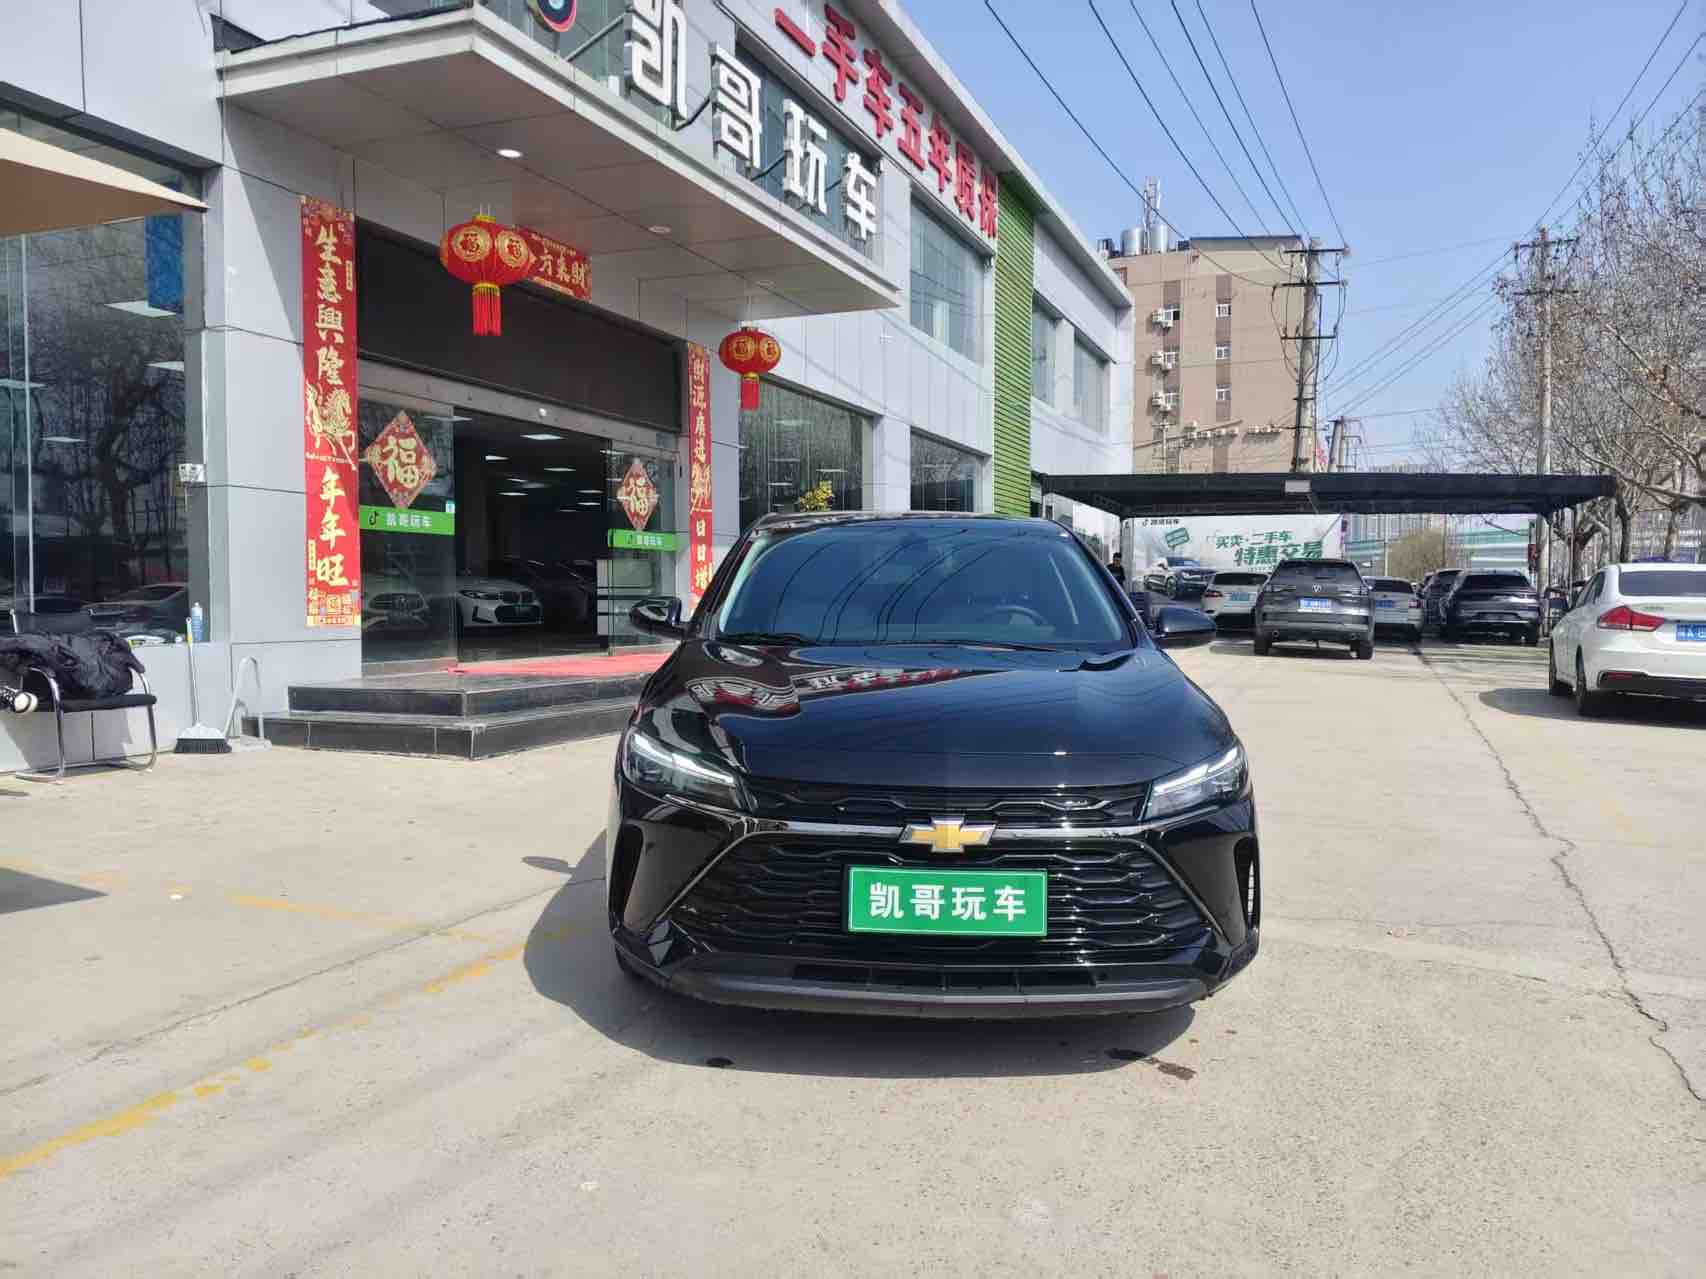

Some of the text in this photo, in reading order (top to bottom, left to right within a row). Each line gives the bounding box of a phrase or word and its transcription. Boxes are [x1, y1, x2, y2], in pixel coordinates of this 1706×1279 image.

[624, 0, 878, 240] 凯哥玩车
[383, 435, 419, 489] 福
[869, 881, 1027, 922] 凯哥玩车
